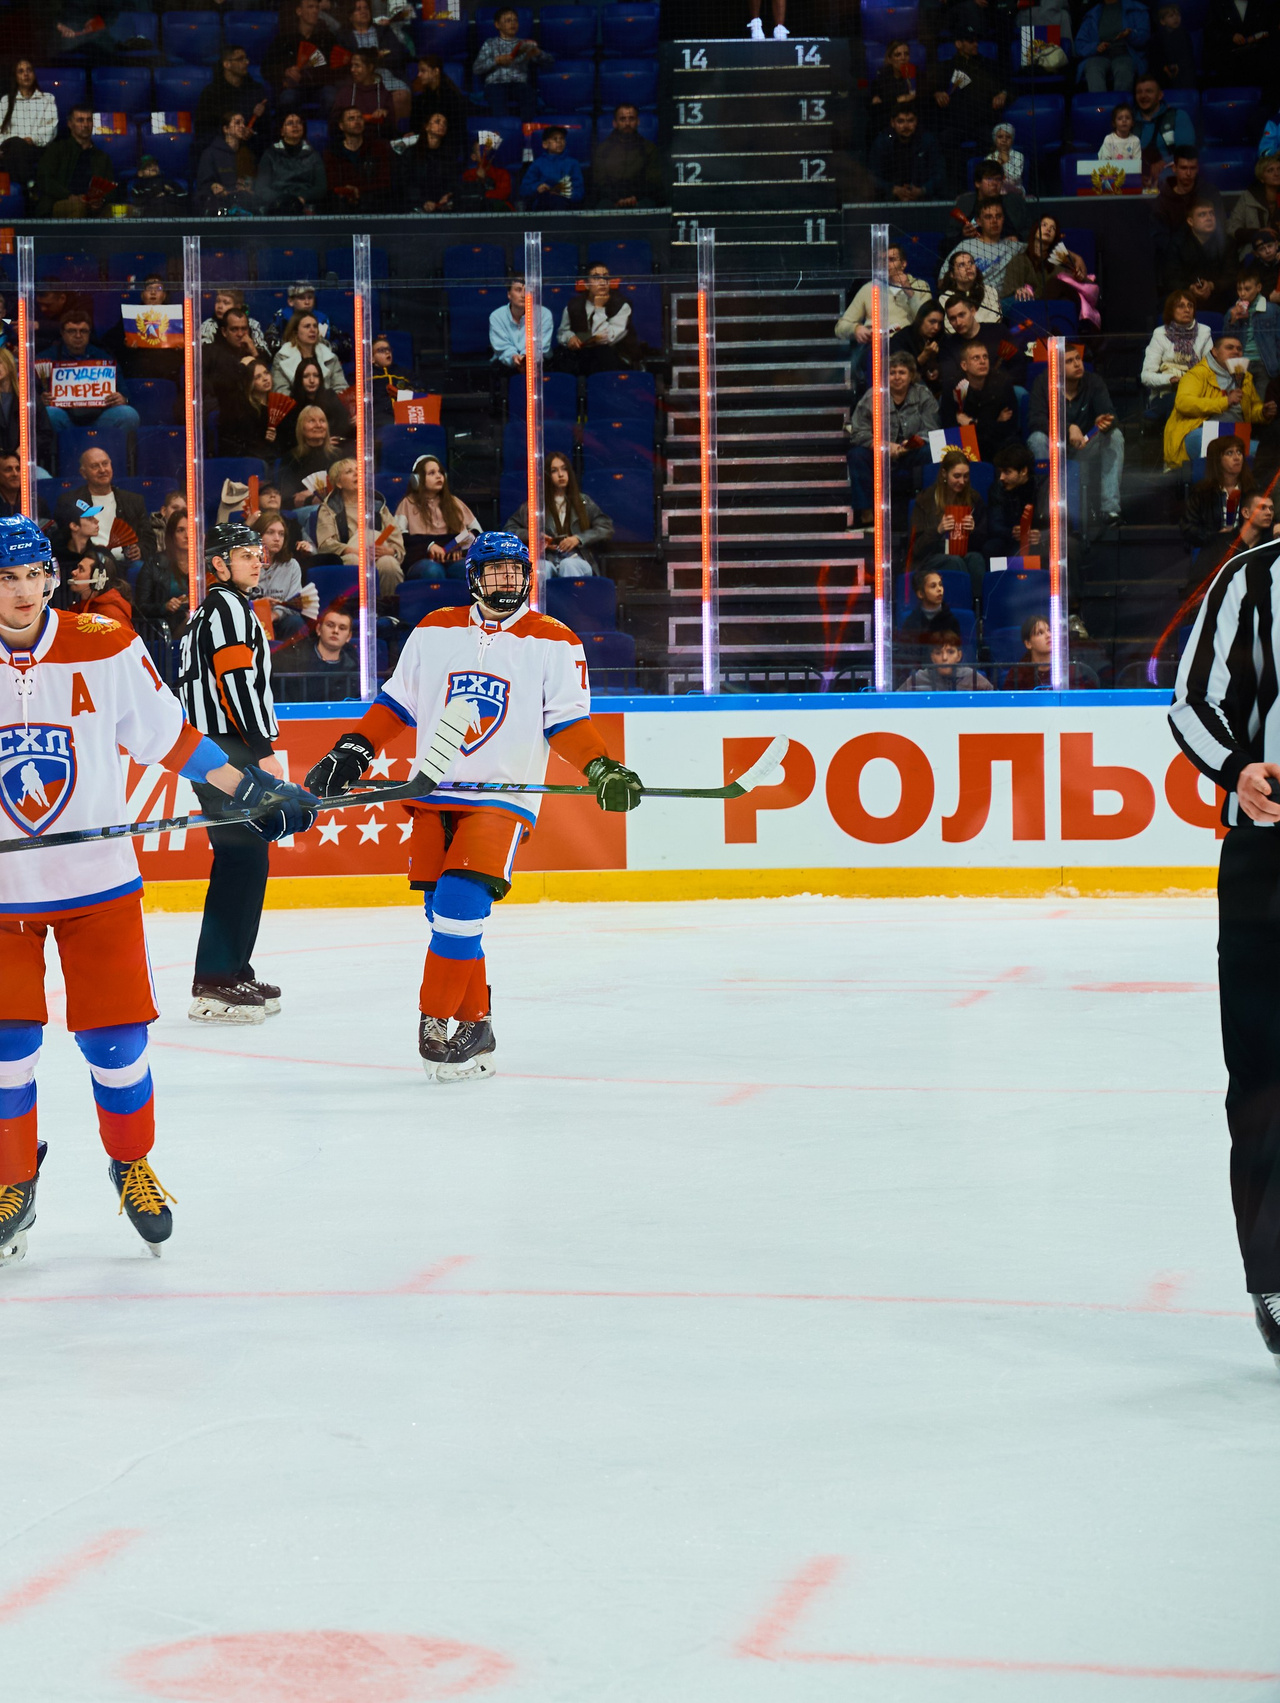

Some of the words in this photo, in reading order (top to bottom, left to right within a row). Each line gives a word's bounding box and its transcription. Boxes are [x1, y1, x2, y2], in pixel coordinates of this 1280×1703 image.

[682, 49, 708, 69] 14
[795, 45, 821, 66] 14
[676, 102, 704, 124] 13
[799, 99, 826, 121] 13
[675, 162, 703, 184] 12
[799, 159, 827, 181] 12
[677, 220, 699, 243] 11
[804, 218, 826, 244] 11
[9, 542, 33, 551] CCM
[575, 660, 587, 690] 7
[71, 672, 96, 717] A
[452, 675, 506, 702] СХЛ
[339, 742, 373, 762] BAU
[101, 815, 189, 837] CCM
